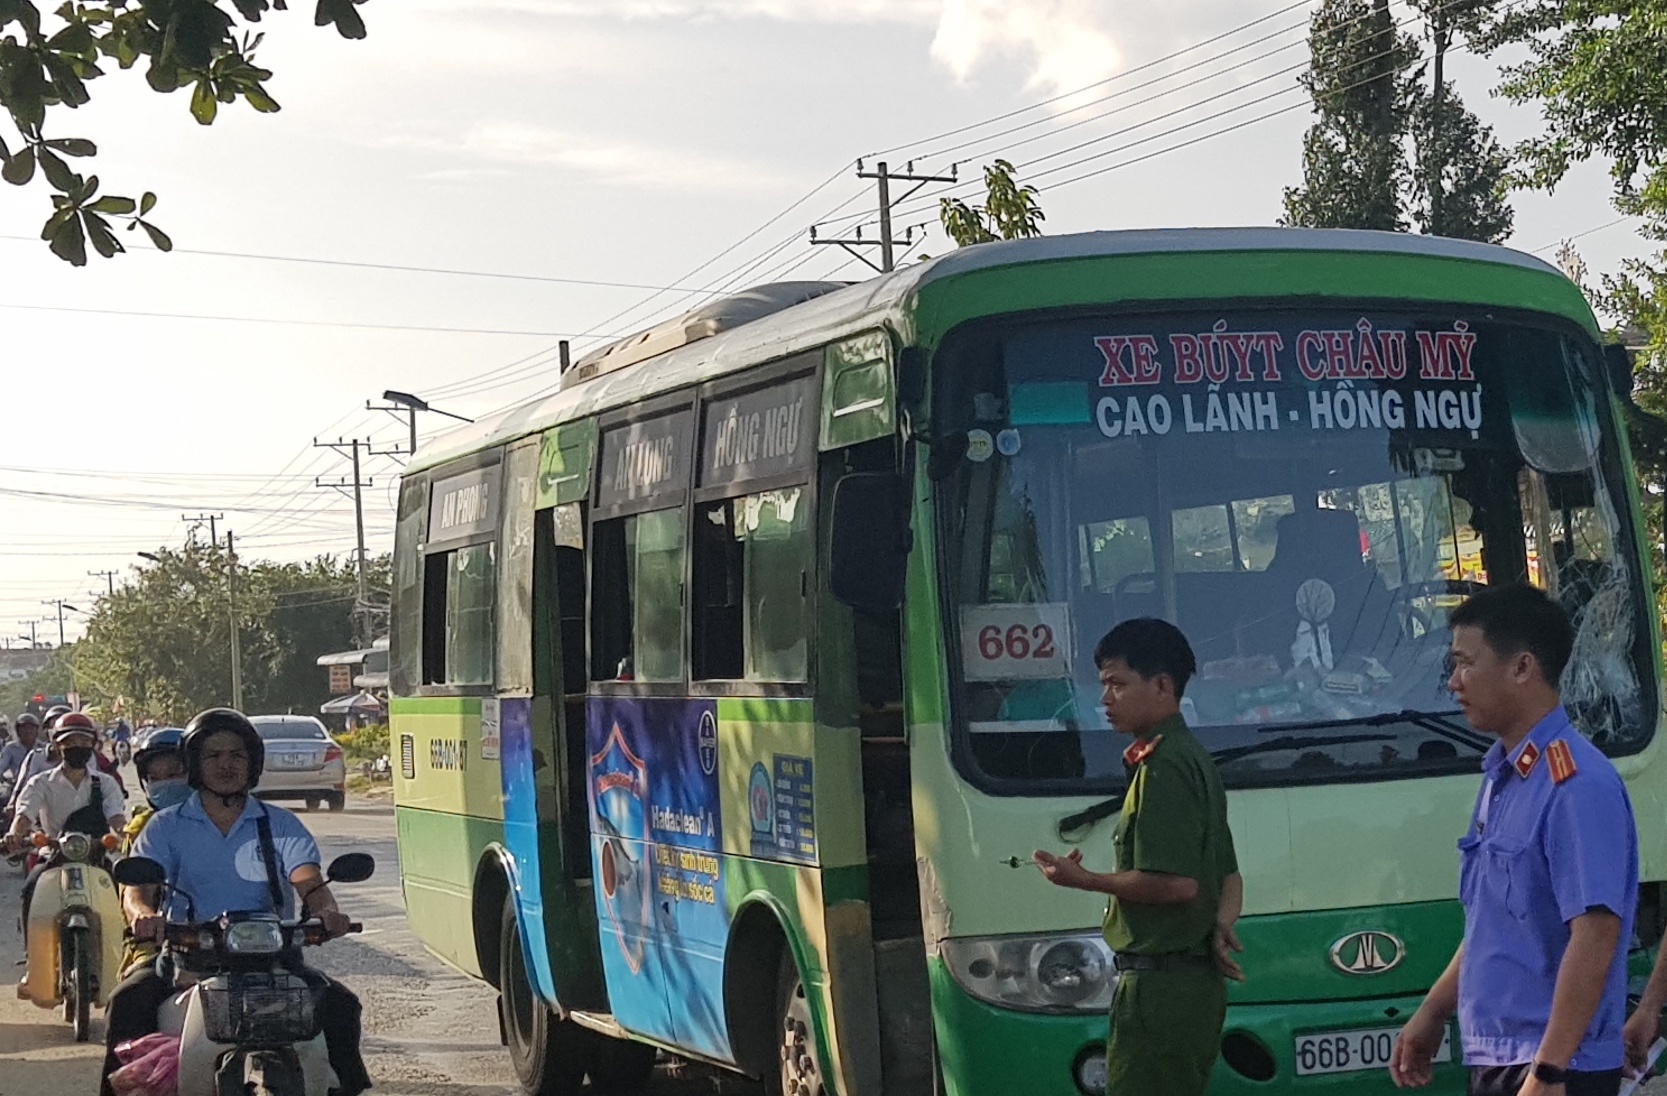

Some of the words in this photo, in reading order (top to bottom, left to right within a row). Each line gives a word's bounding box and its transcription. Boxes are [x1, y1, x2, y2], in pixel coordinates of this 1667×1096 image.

[1094, 334, 1162, 387] XE
[1169, 319, 1284, 384] BÚYT
[1296, 316, 1406, 381] CHÂU
[1415, 320, 1478, 381] MỸ
[714, 402, 760, 469] HỒNG
[1096, 397, 1172, 438] CAO
[1183, 384, 1279, 433] LÃNH
[1307, 380, 1406, 430] HỒNG
[1413, 384, 1482, 440] NGỰ
[978, 623, 1054, 660] 662
